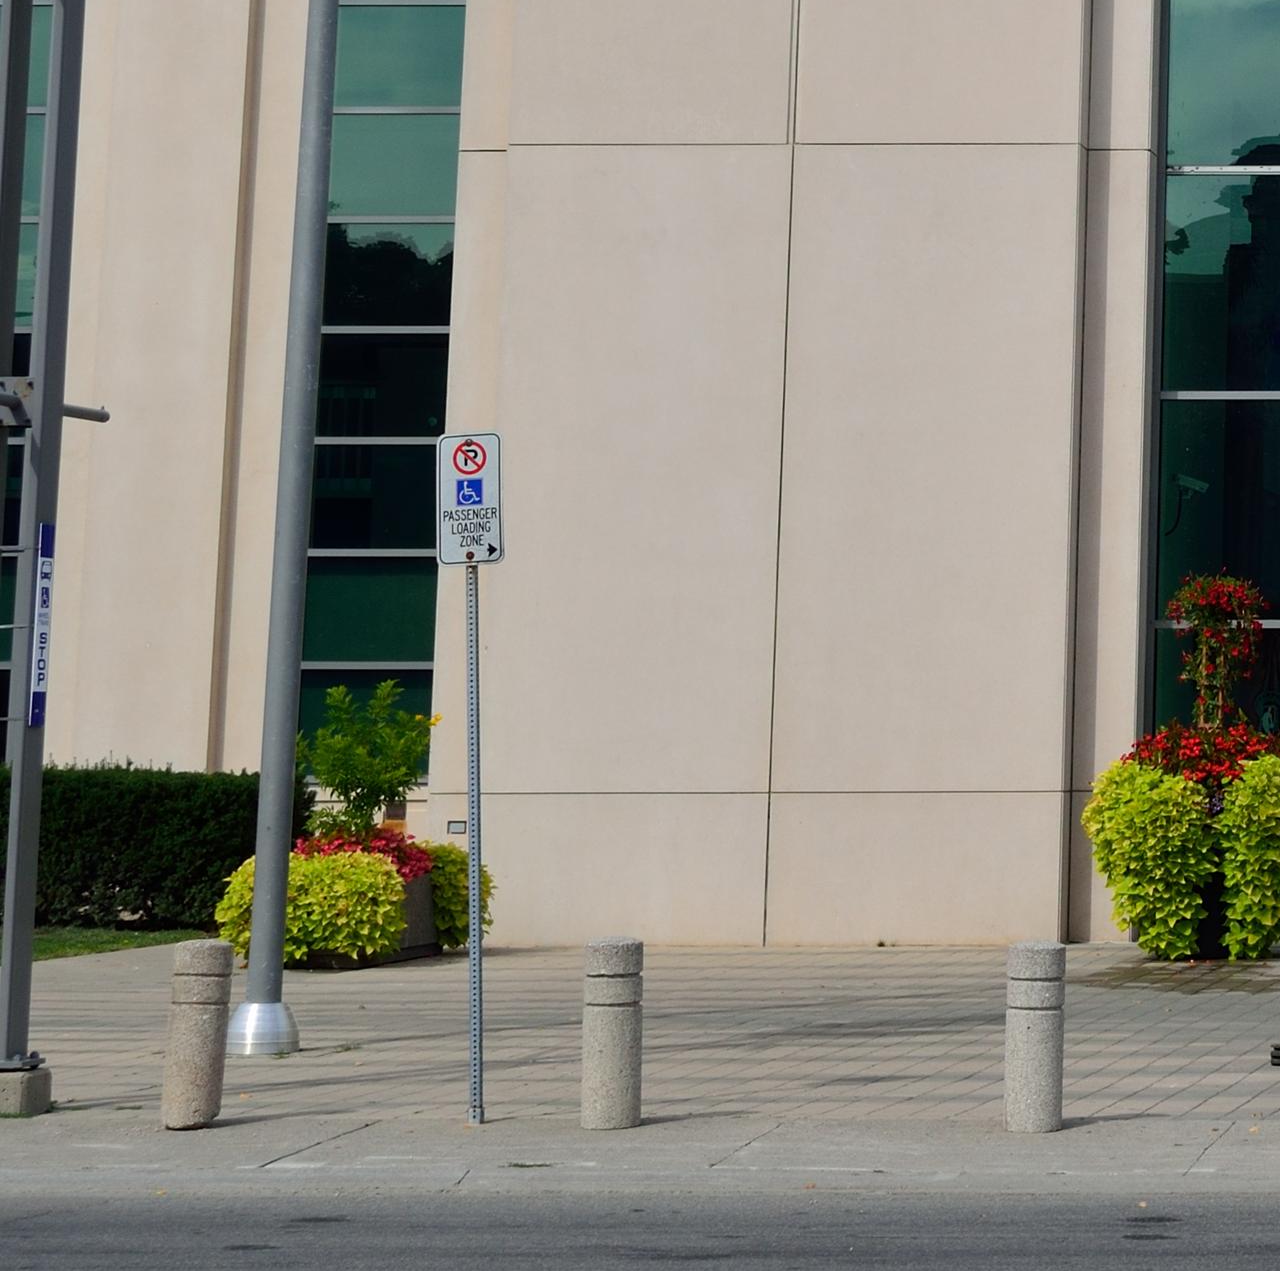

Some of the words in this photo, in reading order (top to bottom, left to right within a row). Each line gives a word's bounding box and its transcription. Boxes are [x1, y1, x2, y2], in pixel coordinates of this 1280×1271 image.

[443, 508, 497, 522] PASSENGER
[451, 521, 491, 535] LOADING
[460, 535, 484, 547] ZONE
[37, 632, 47, 686] STOP
